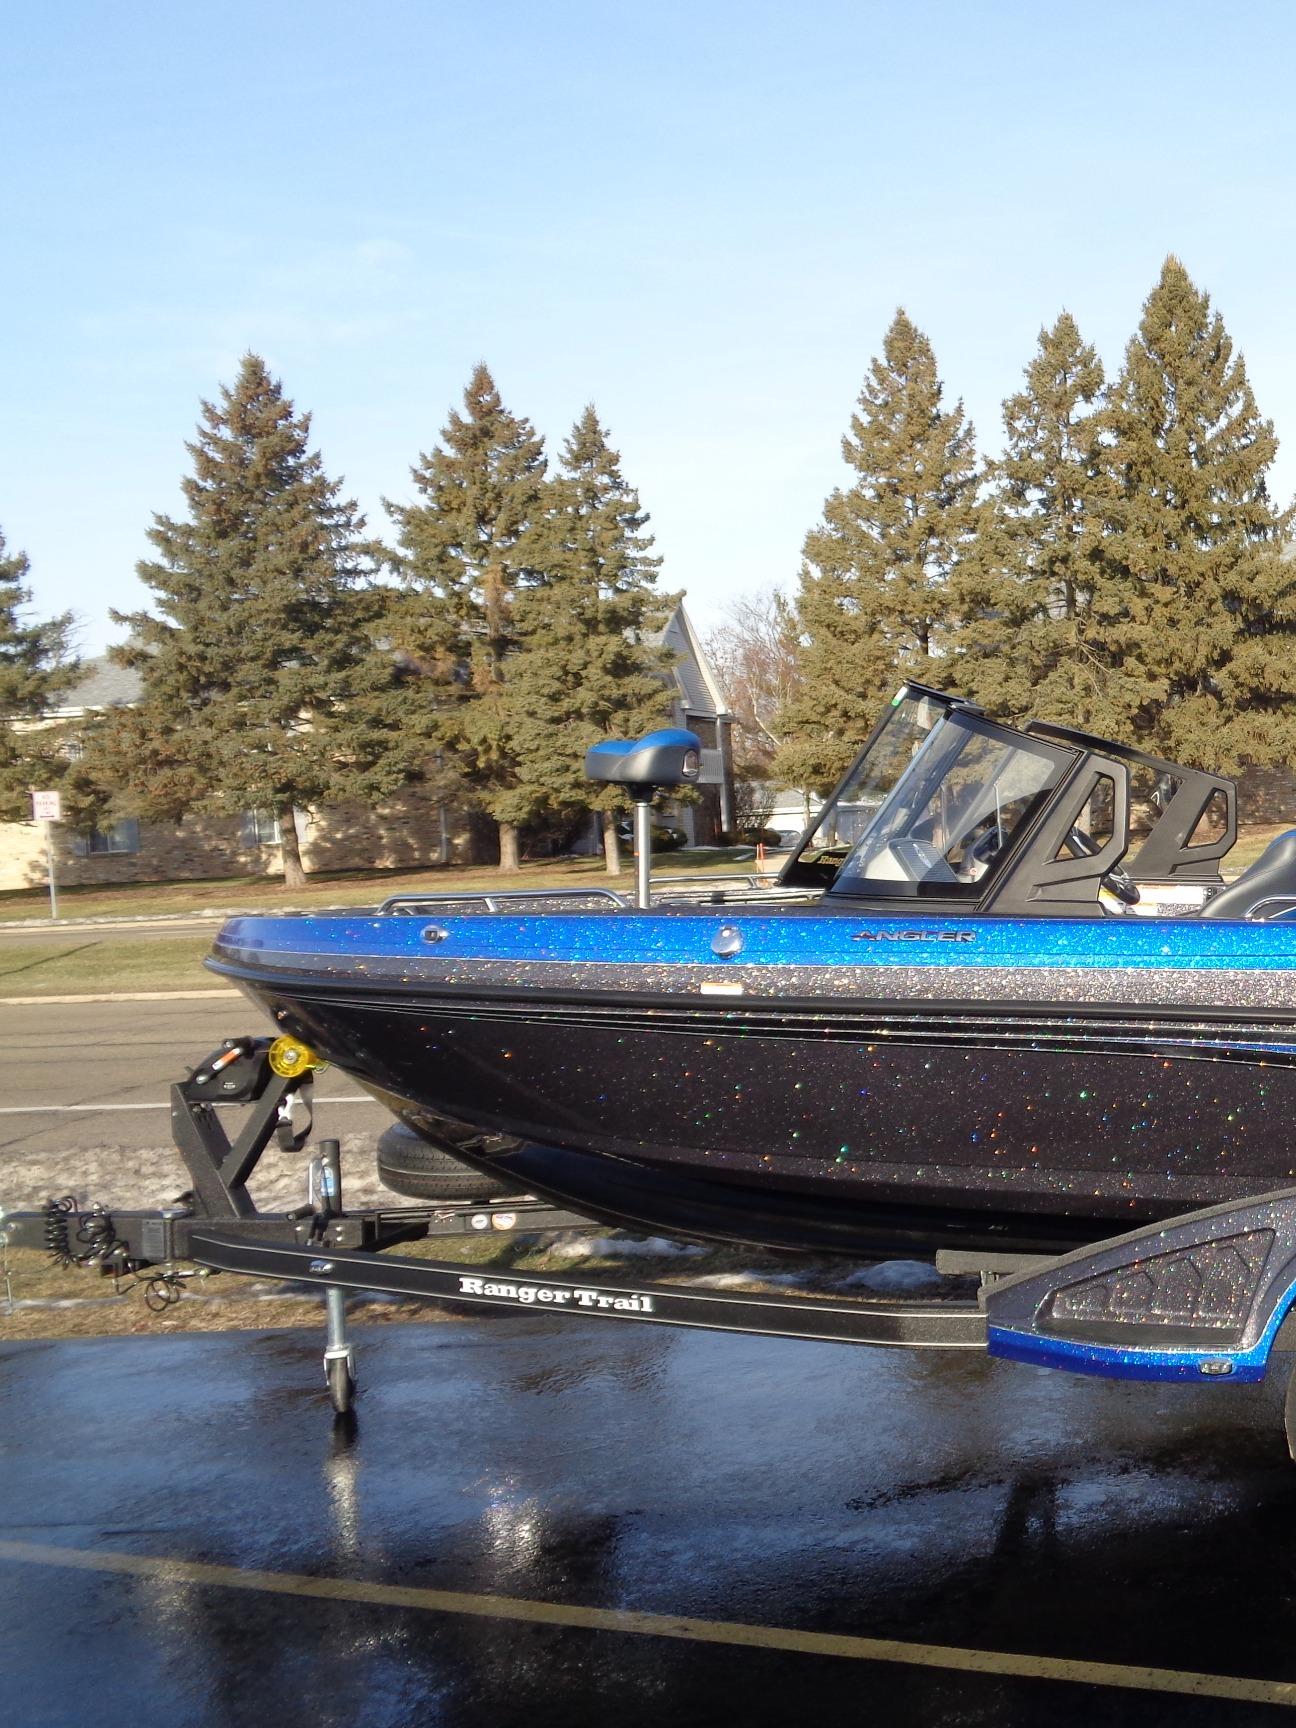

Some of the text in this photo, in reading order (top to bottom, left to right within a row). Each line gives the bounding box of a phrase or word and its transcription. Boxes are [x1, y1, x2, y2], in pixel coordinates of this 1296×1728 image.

[851, 931, 977, 942] ANGLER
[458, 1277, 653, 1313] Ranger Trail
